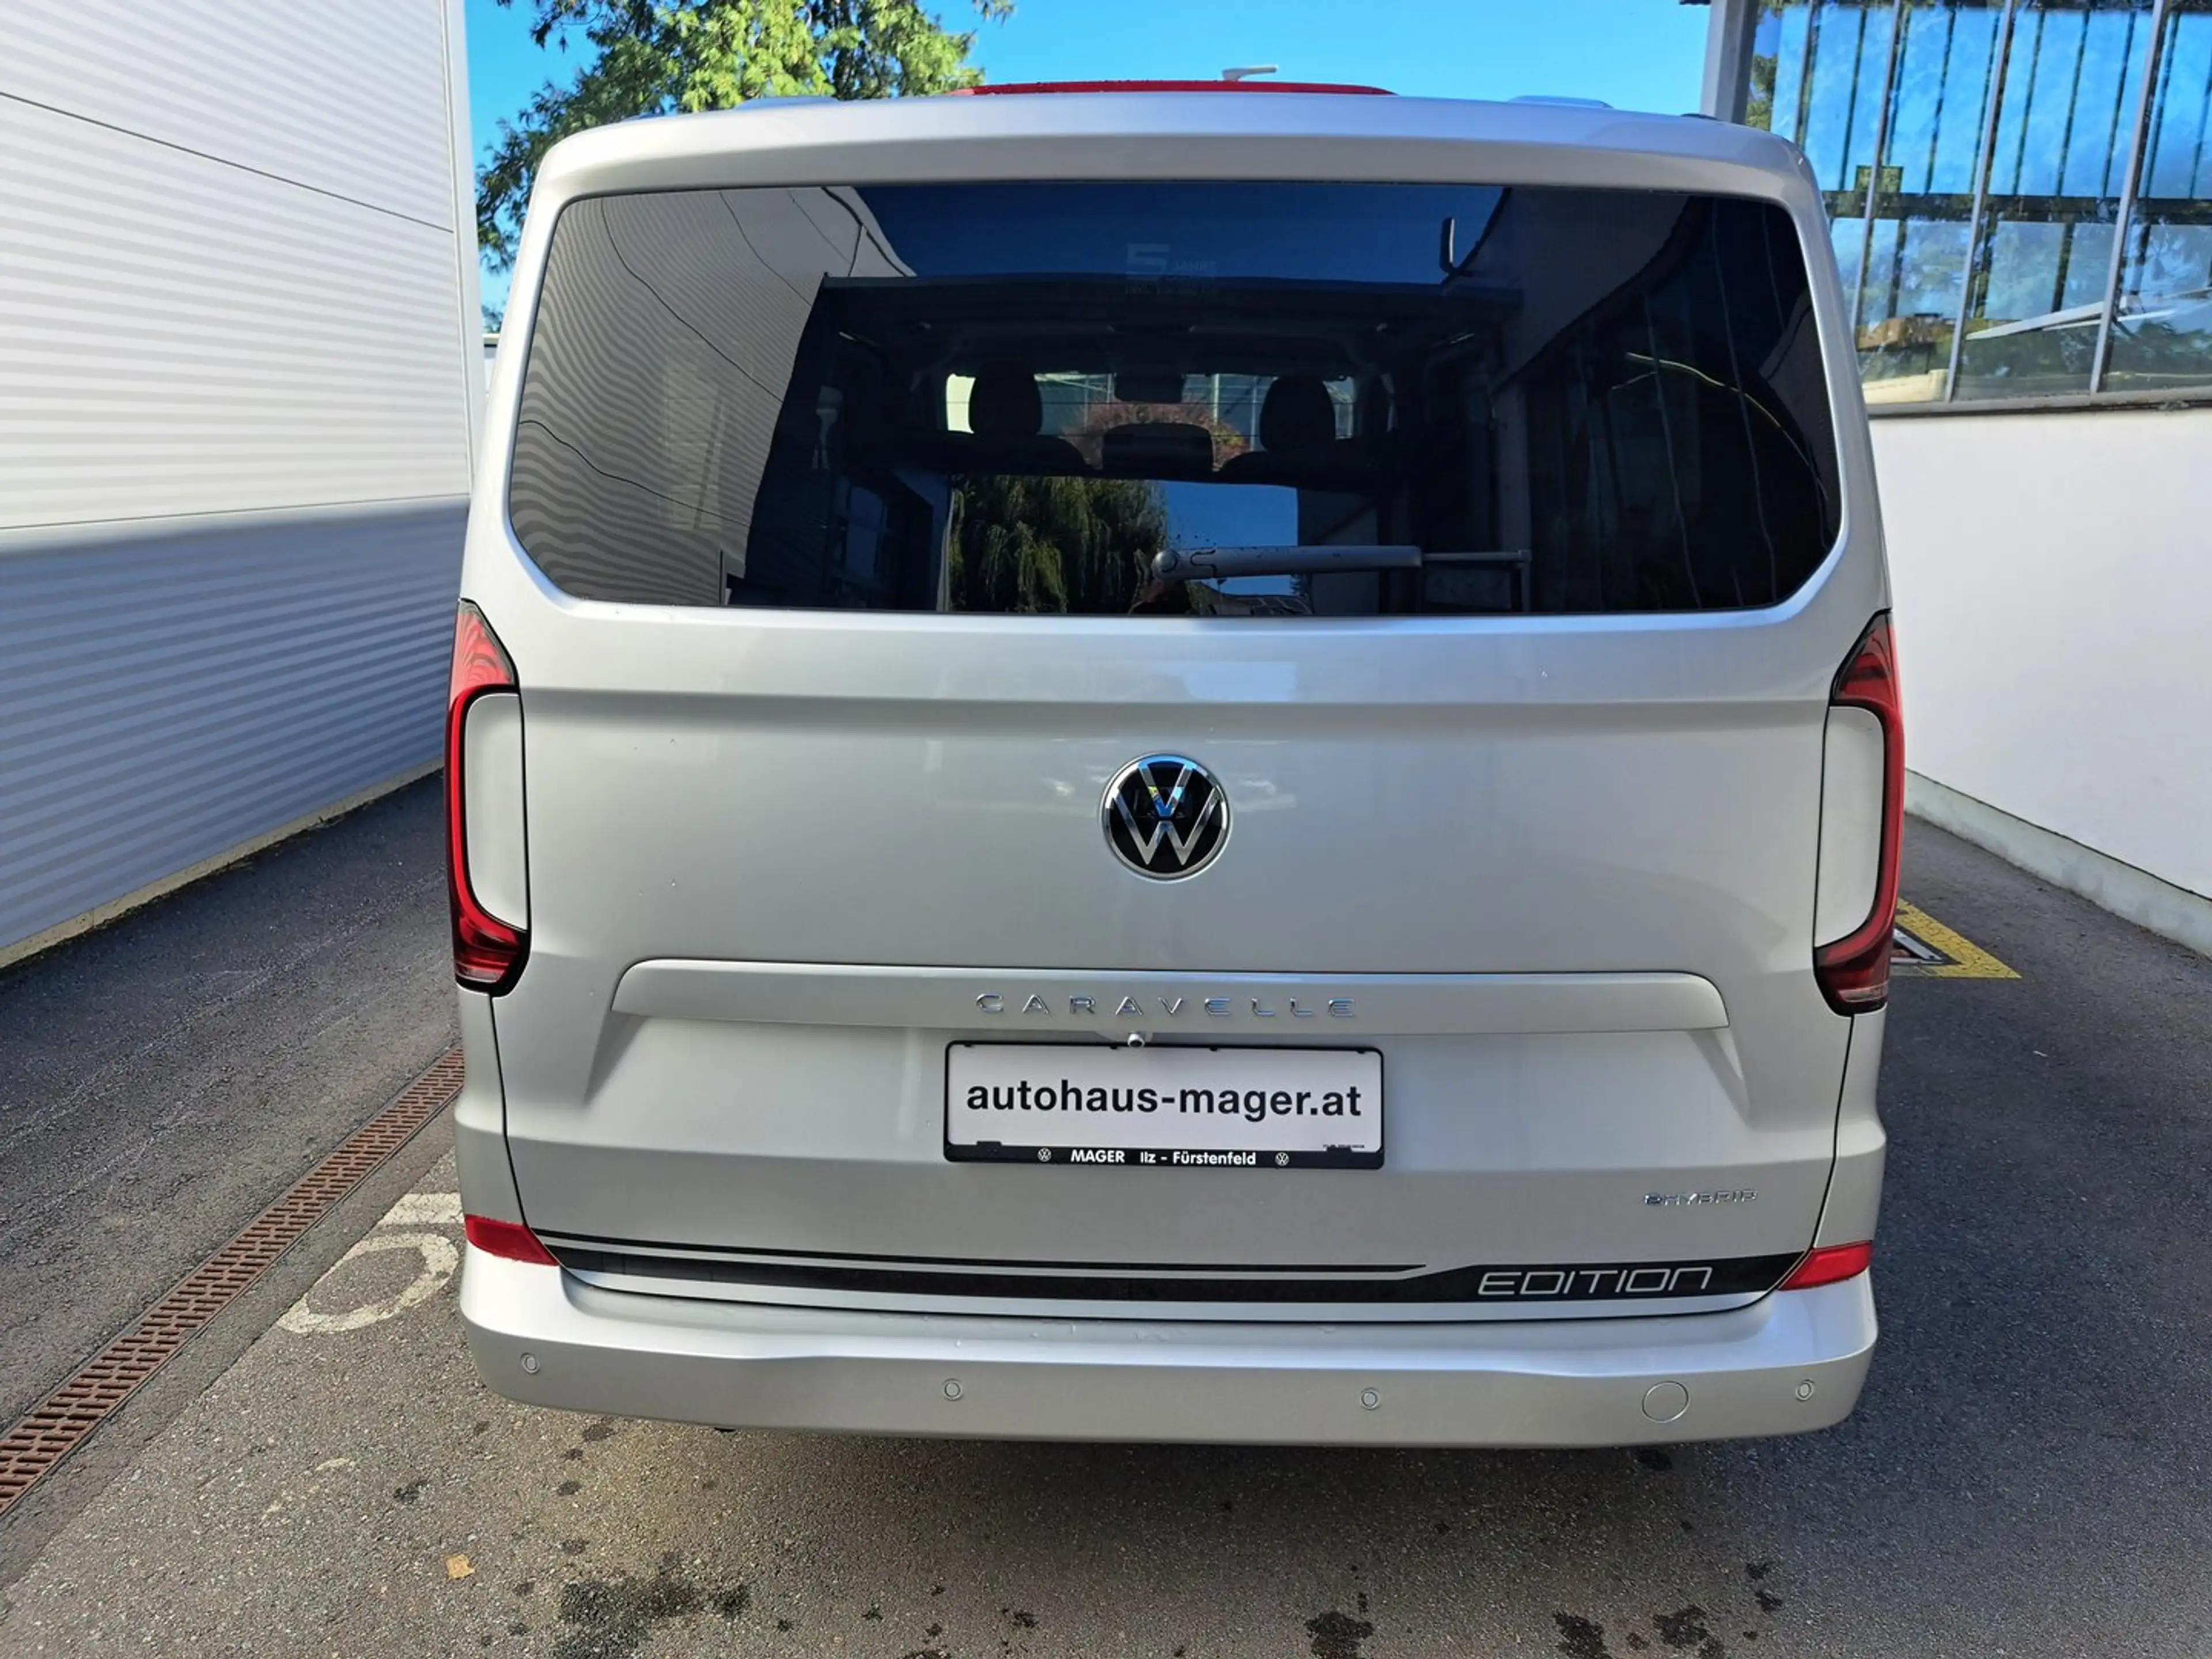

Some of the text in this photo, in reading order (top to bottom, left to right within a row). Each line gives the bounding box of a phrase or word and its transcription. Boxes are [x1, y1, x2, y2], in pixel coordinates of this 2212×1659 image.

[1105, 755, 1228, 873] VW
[976, 993, 1355, 1018] CARAVELLE
[966, 1081, 1362, 1123] autohaus-mager.at
[1070, 1149, 1126, 1164] MAGER
[1140, 1151, 1157, 1164] Ilz
[1173, 1150, 1257, 1166] Fürstenfeld
[1477, 1267, 1713, 1296] EDITION
